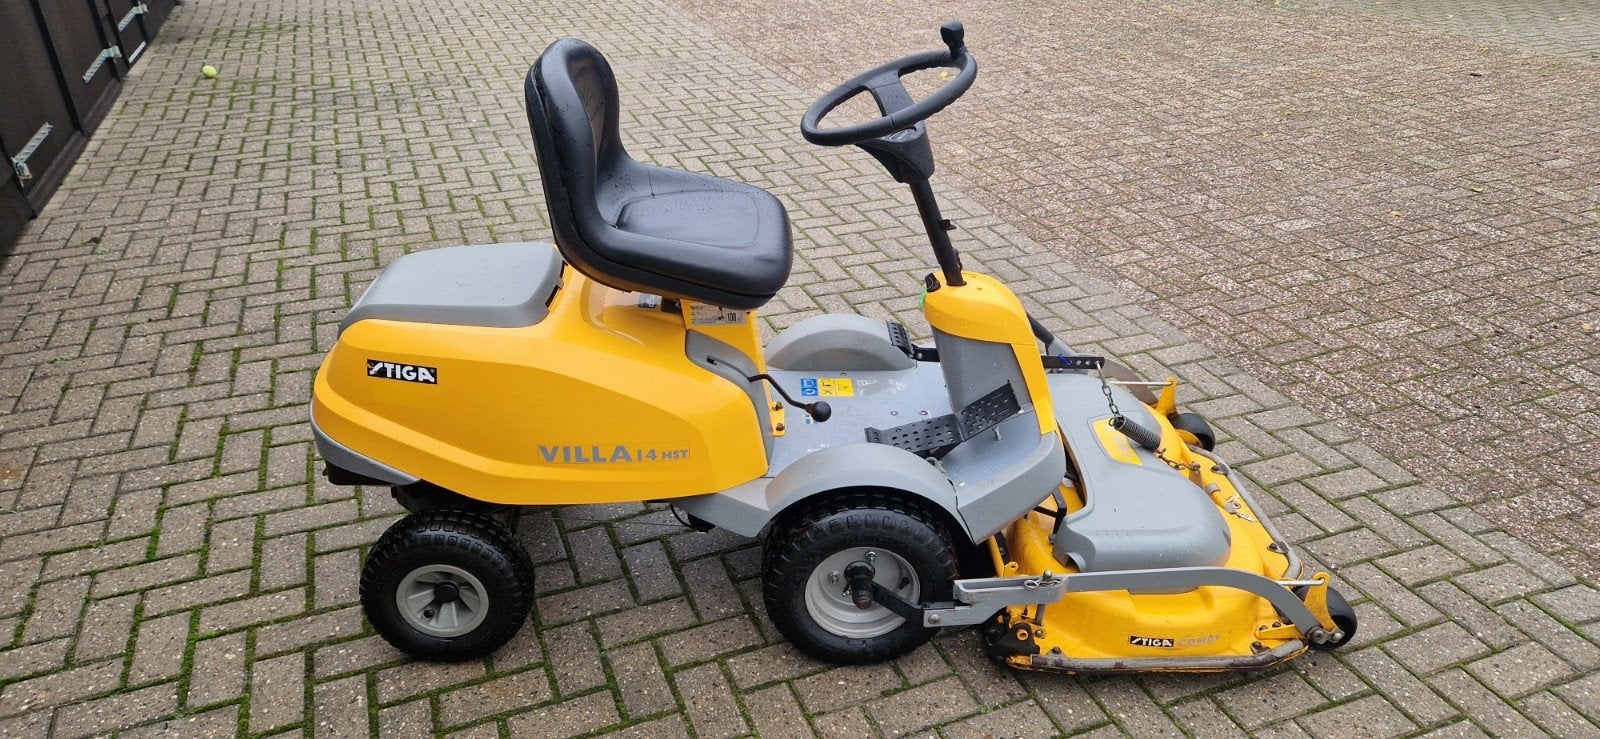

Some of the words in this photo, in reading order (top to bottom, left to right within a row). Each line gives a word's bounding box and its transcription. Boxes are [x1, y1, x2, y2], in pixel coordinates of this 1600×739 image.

[369, 362, 435, 383] STIGA
[538, 445, 633, 463] VILLA
[662, 449, 690, 460] HST
[1131, 638, 1173, 647] STIGA
